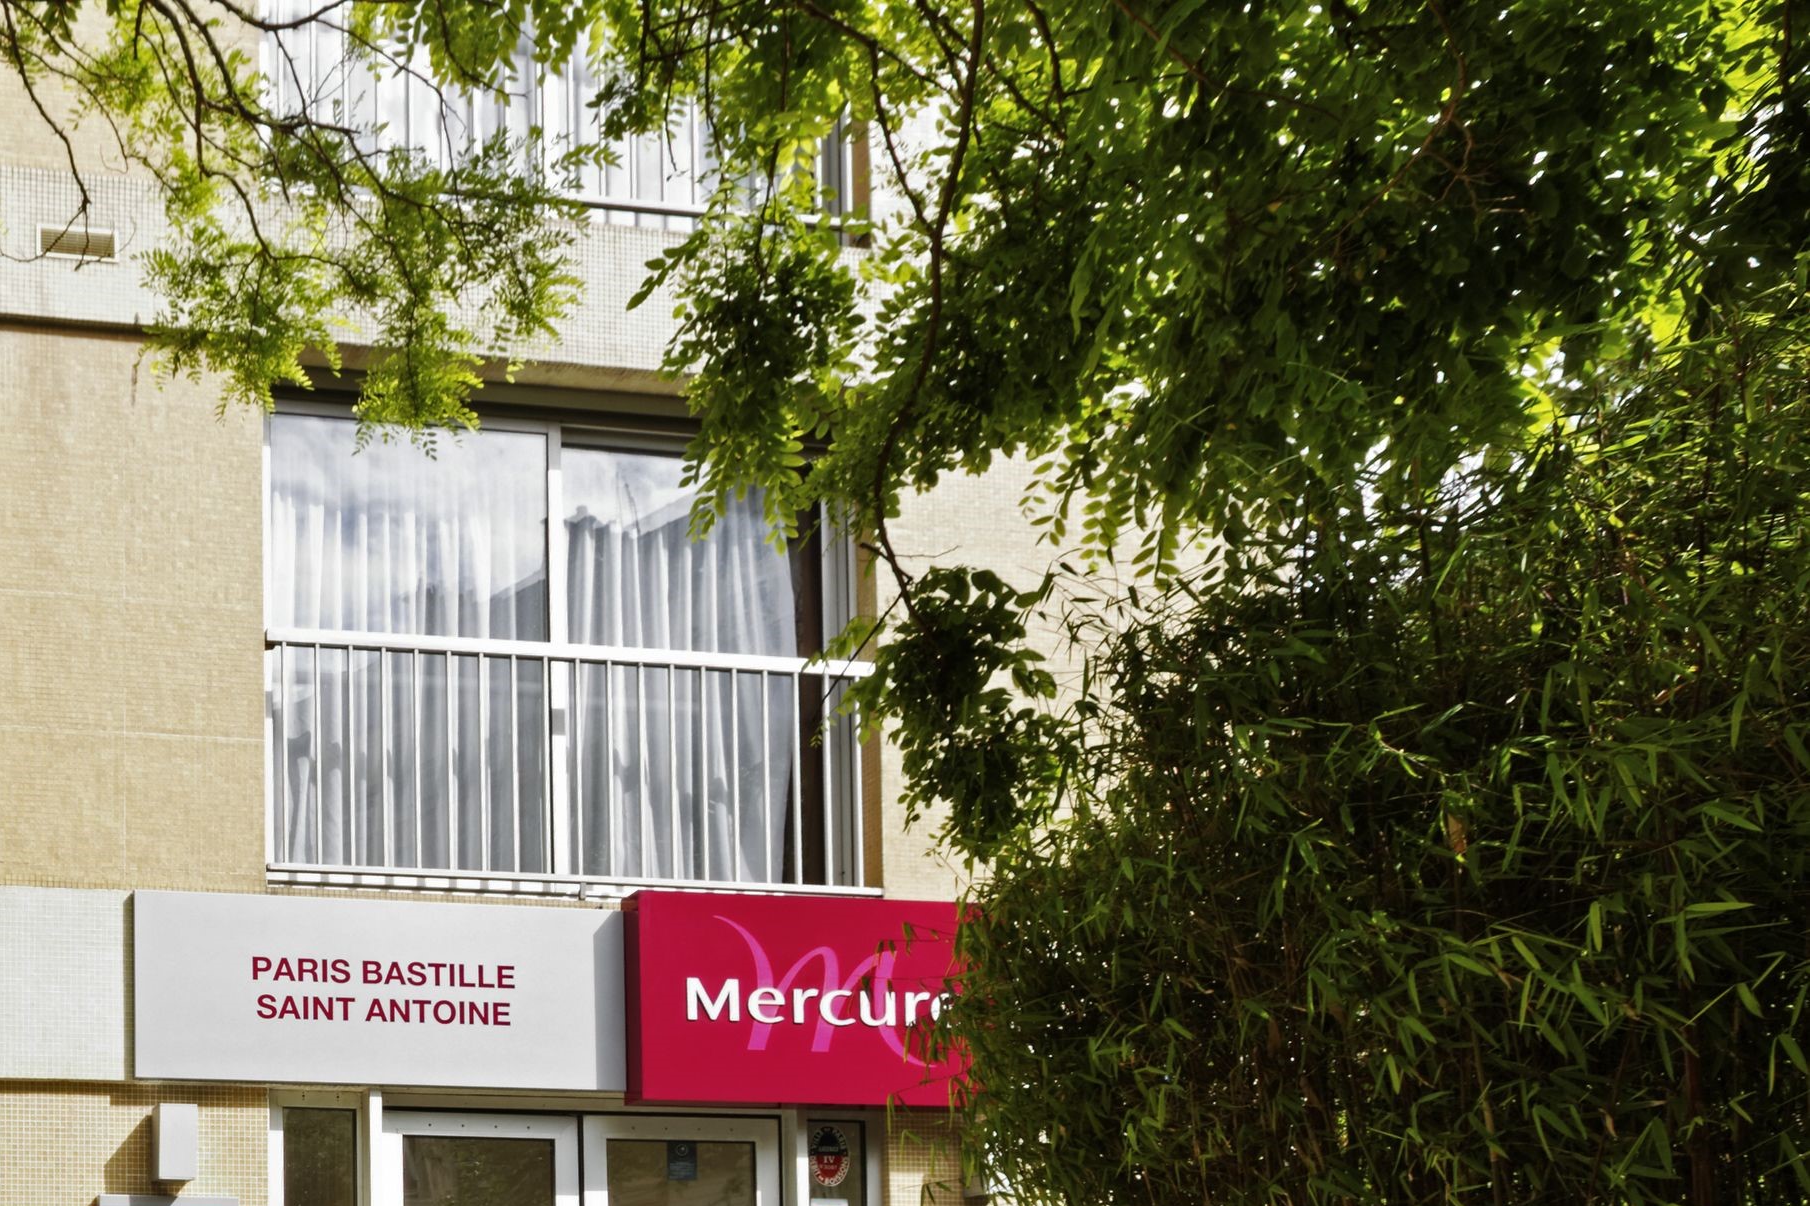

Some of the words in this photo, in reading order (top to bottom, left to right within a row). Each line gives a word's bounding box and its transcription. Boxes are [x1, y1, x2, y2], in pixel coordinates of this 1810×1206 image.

[251, 956, 351, 984] PARIS
[362, 960, 516, 989] BASTILLE
[256, 993, 356, 1021] SAINT
[365, 998, 511, 1026] ANTOINE
